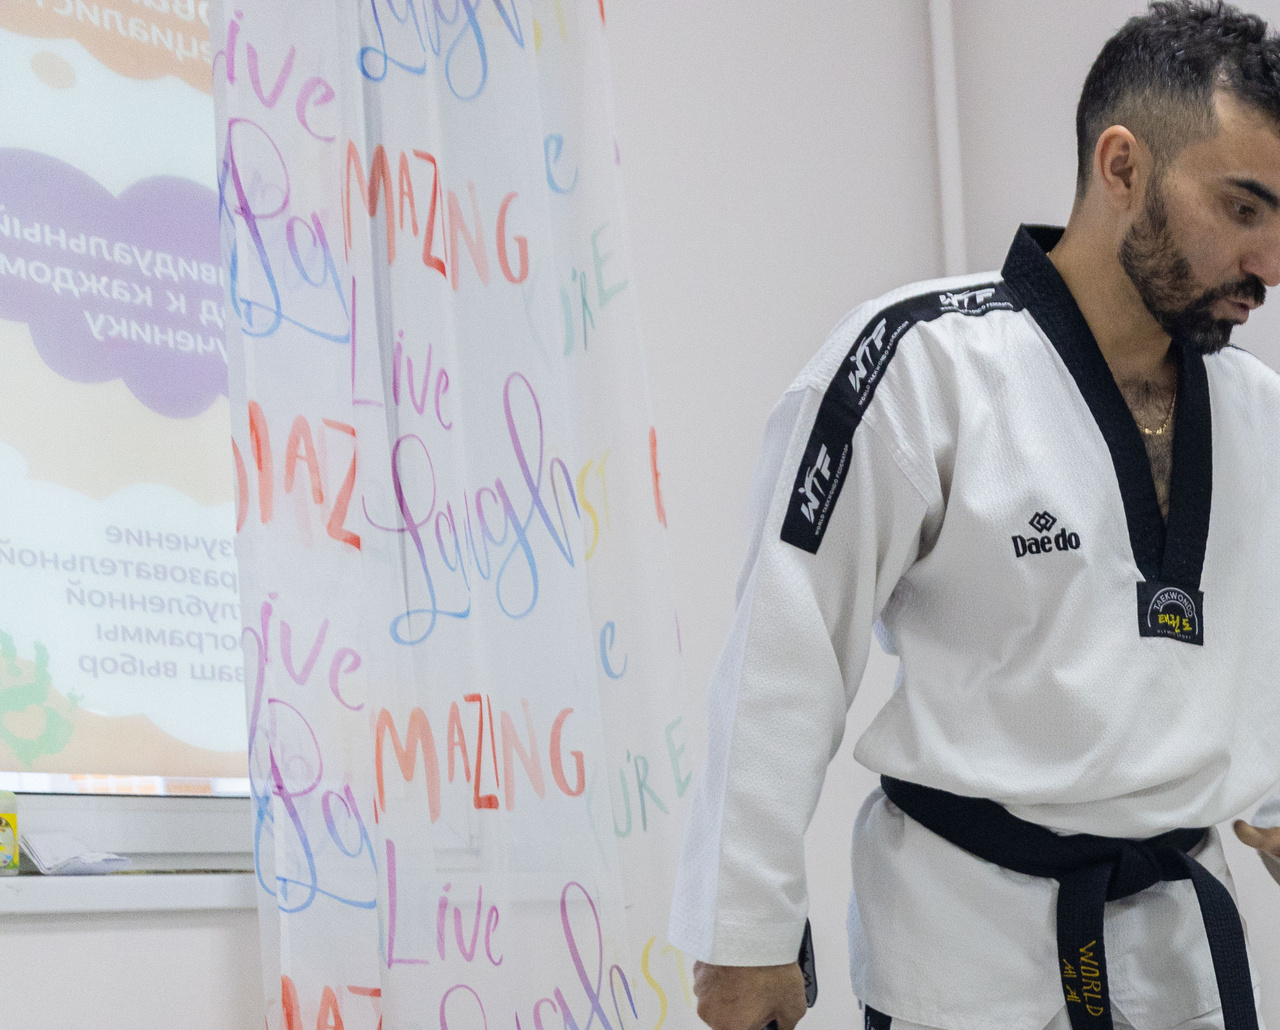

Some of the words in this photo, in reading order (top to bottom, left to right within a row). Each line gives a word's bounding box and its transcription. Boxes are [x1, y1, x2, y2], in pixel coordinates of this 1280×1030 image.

[1153, 591, 1194, 617] TAEKWONDO
[371, 692, 586, 824] MAZING
[386, 837, 504, 969] Live
[1079, 940, 1104, 1017] WORLD
